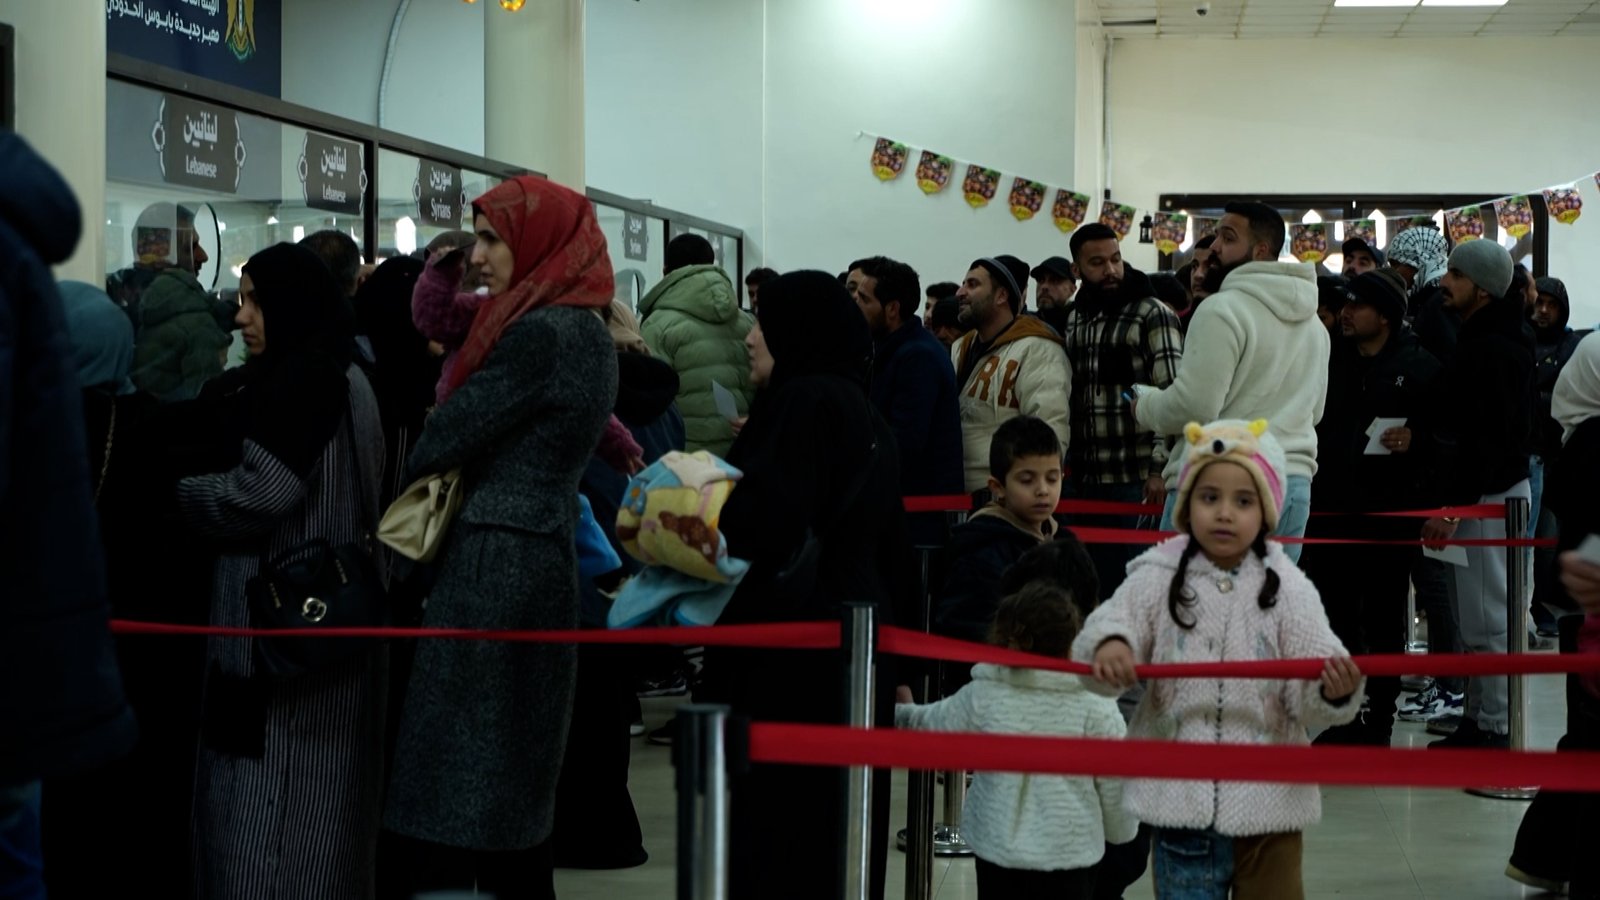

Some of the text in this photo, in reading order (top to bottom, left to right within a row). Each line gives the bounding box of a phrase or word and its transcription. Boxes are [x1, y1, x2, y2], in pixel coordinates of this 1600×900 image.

[145, 8, 174, 34] يابوس
[175, 12, 201, 42] جديدة
[201, 26, 220, 46] معبر
[183, 110, 218, 151] لبنانيين
[185, 154, 217, 179] Lebanese
[322, 183, 347, 204] Lebanese
[431, 197, 452, 222] Syrians
